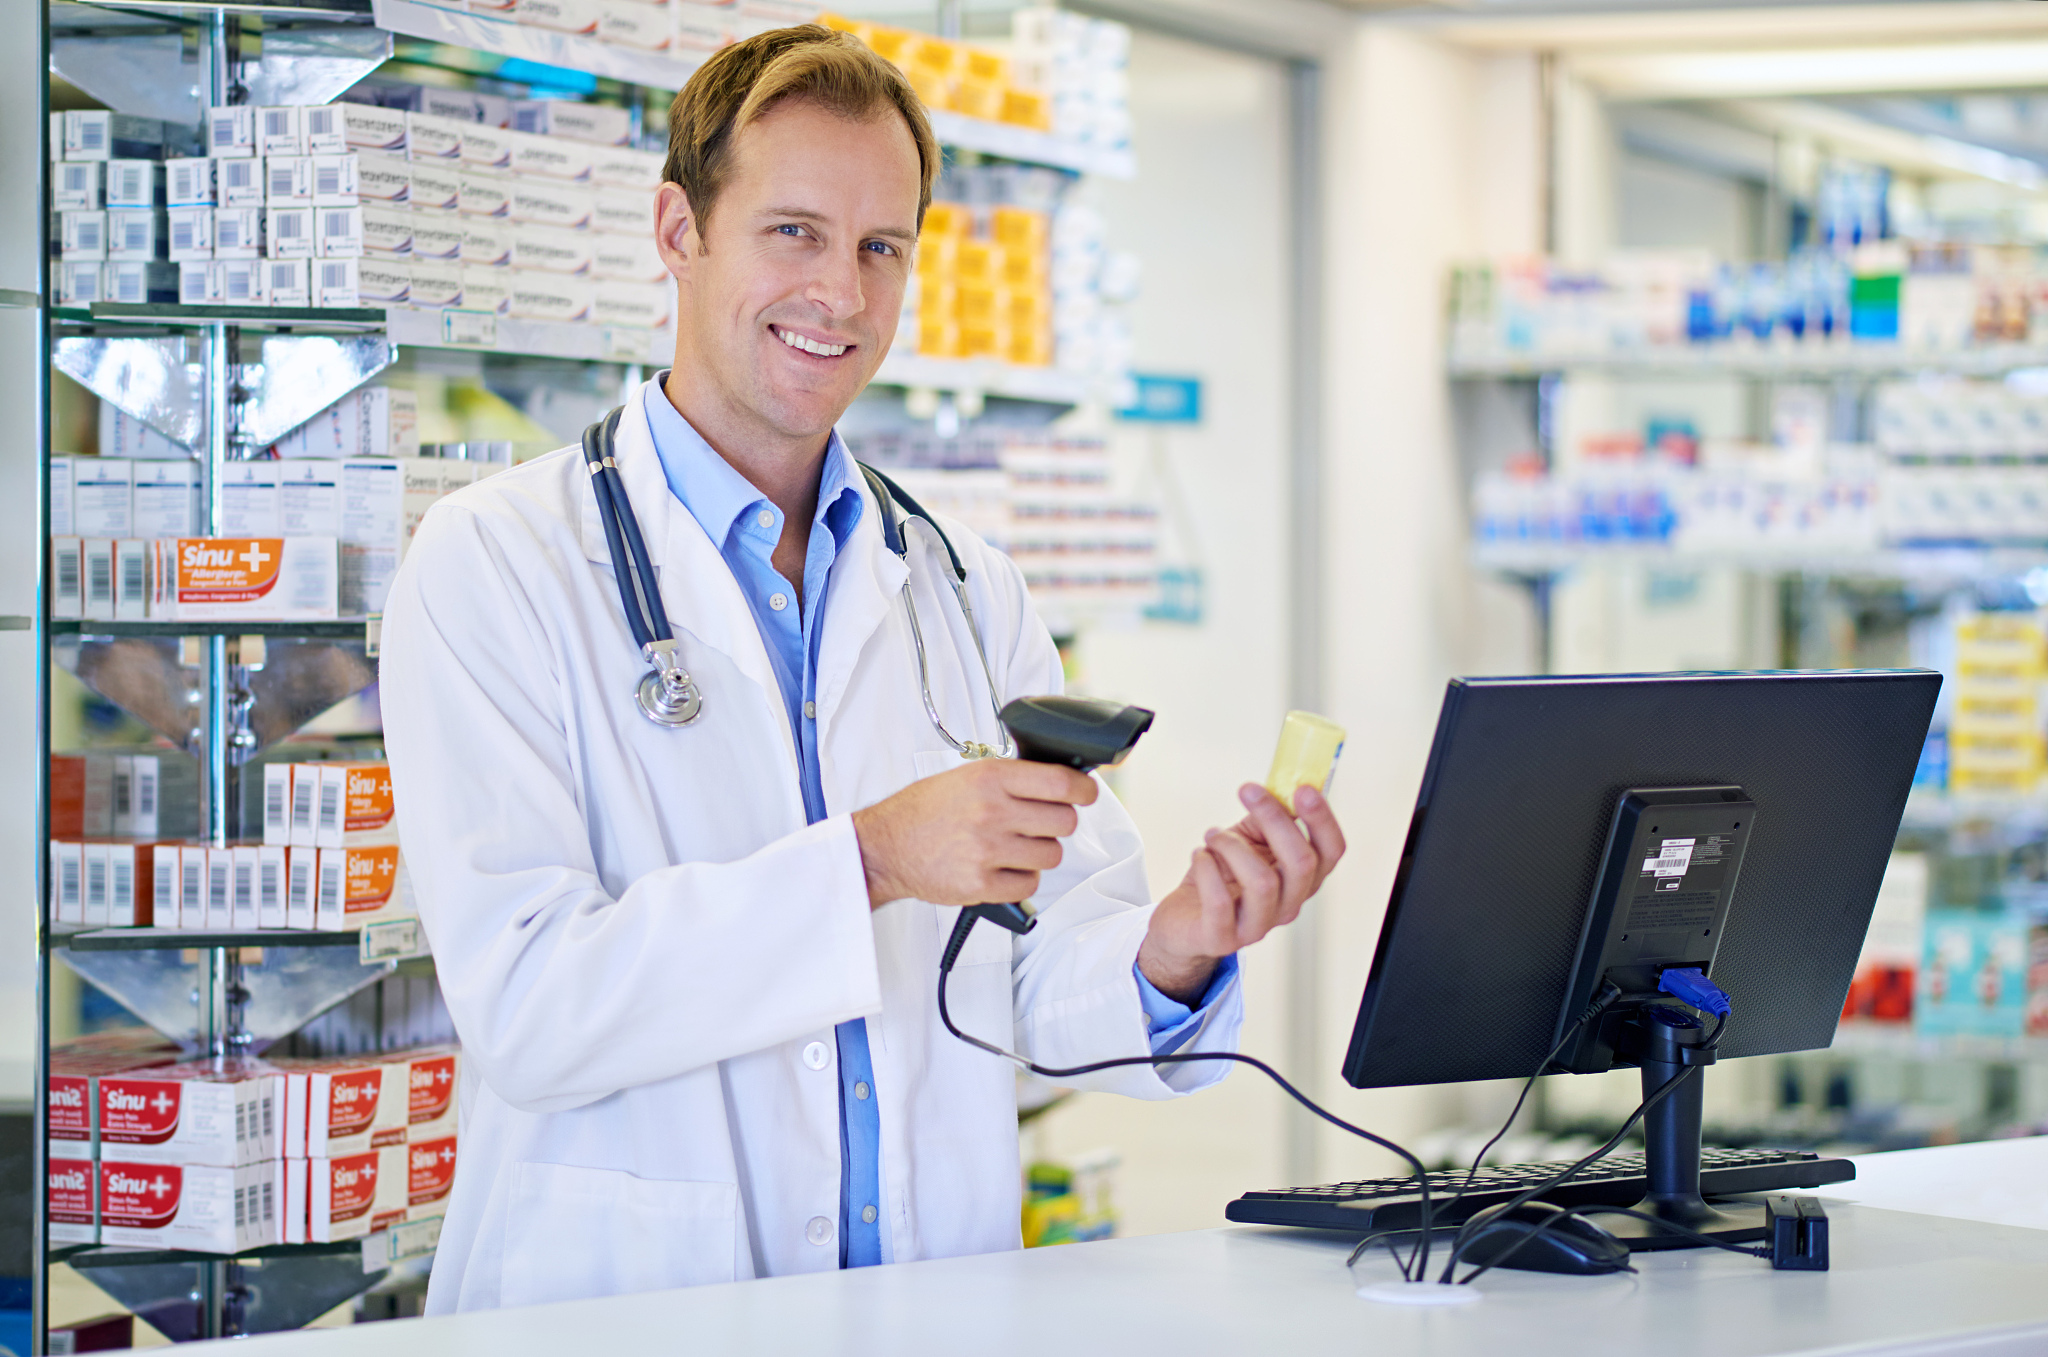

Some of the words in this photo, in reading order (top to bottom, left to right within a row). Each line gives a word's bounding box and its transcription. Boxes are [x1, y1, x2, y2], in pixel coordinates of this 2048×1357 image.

[182, 542, 234, 567] Sinu
[348, 771, 377, 796] Sinu
[348, 853, 374, 878] Sinu
[106, 1088, 146, 1111] Sinu
[333, 1082, 359, 1104] Sinu
[108, 1172, 148, 1195] Sinu
[334, 1165, 359, 1189] Sinu
